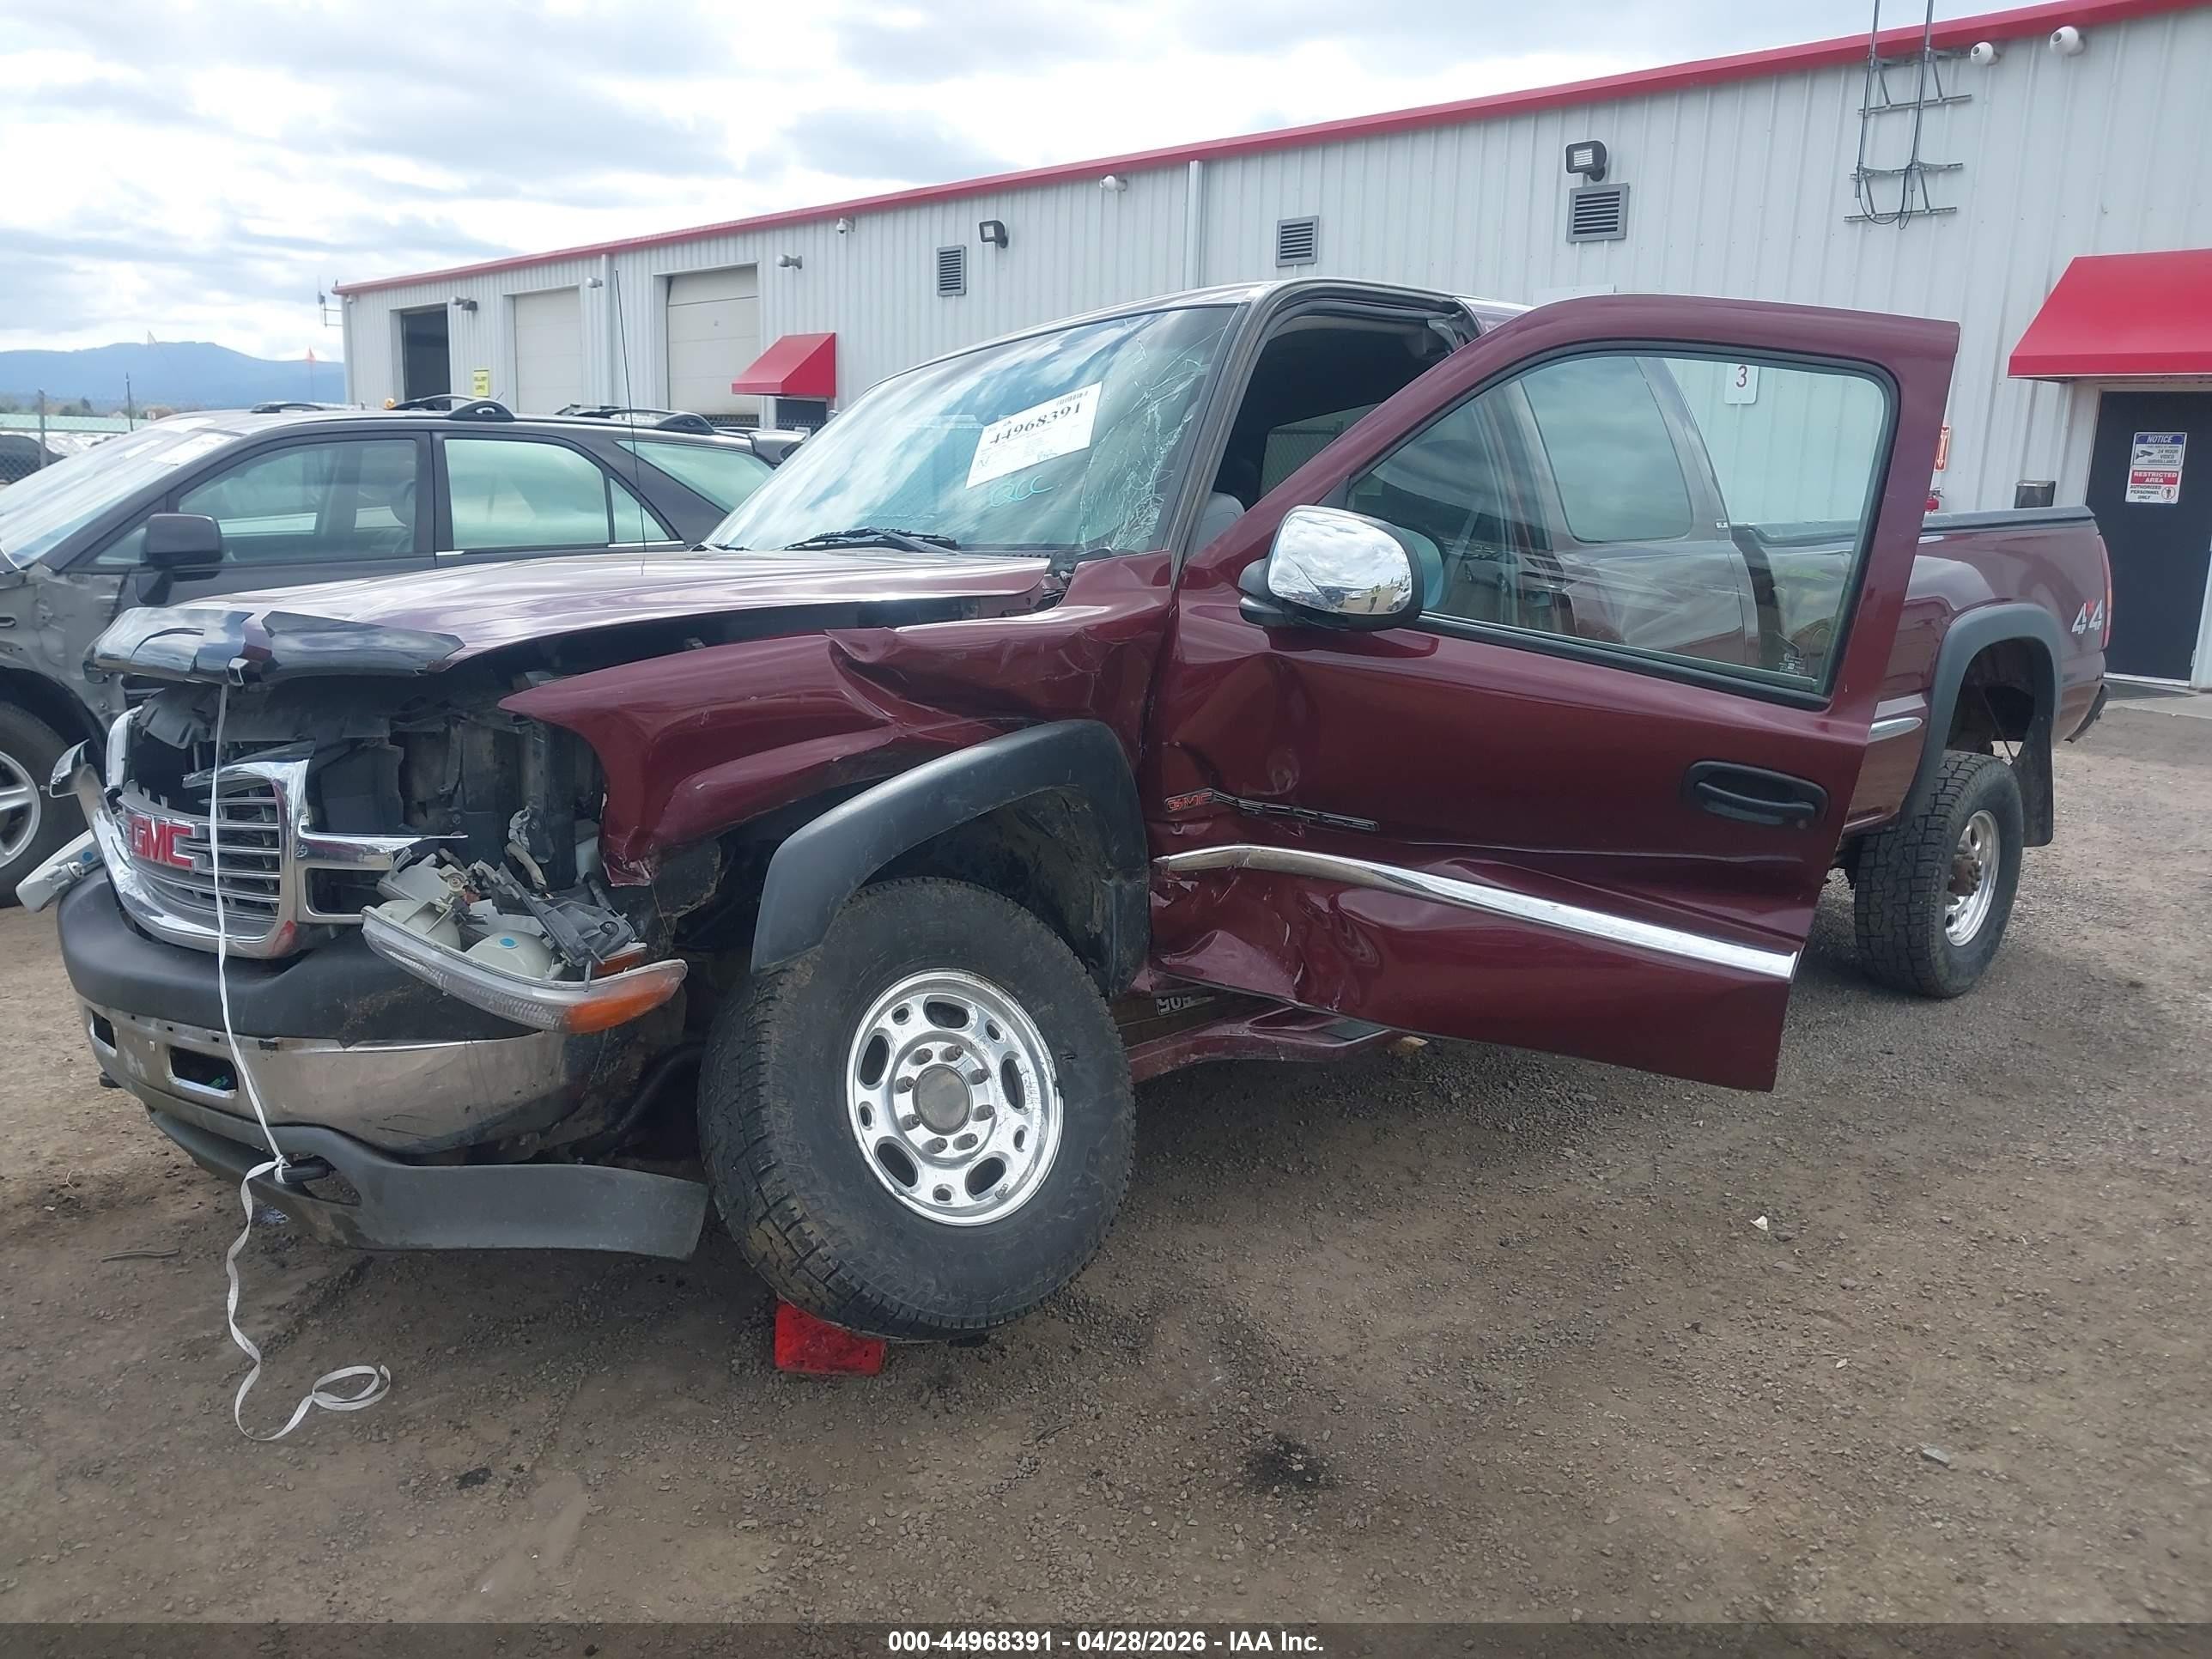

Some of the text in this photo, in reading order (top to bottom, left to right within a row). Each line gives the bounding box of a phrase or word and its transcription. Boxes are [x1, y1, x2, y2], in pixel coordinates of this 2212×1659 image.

[1736, 365, 1747, 388] 3
[989, 402, 1082, 445] 44968391
[2146, 434, 2173, 444] NOTICE
[1165, 790, 1214, 812] GMC
[129, 814, 195, 872] GMC
